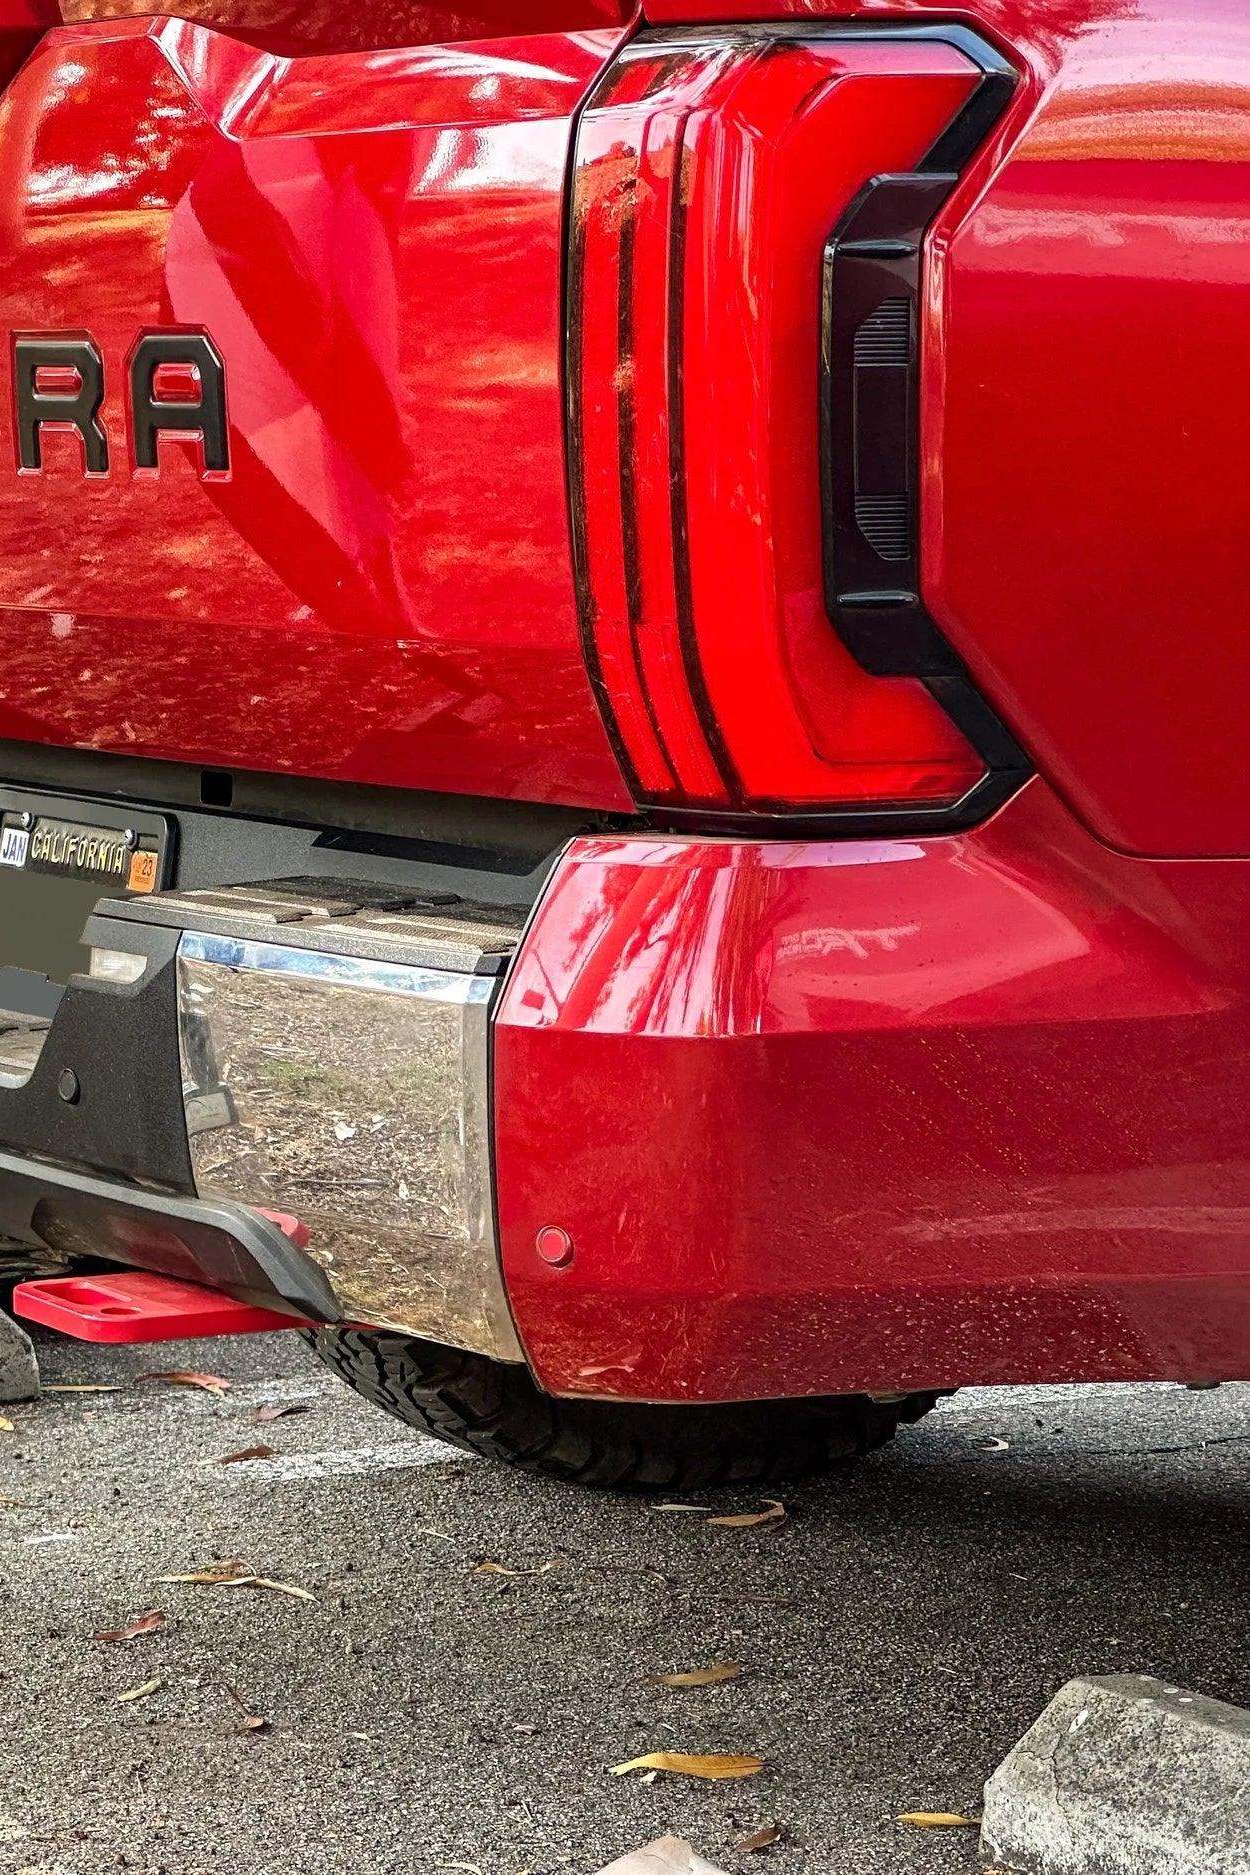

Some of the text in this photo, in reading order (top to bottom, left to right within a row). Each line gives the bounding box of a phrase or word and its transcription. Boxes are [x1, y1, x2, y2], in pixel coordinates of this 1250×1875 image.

[2, 833, 28, 863] JAN
[31, 832, 126, 874] CALIFORNIA
[142, 859, 153, 876] 23
